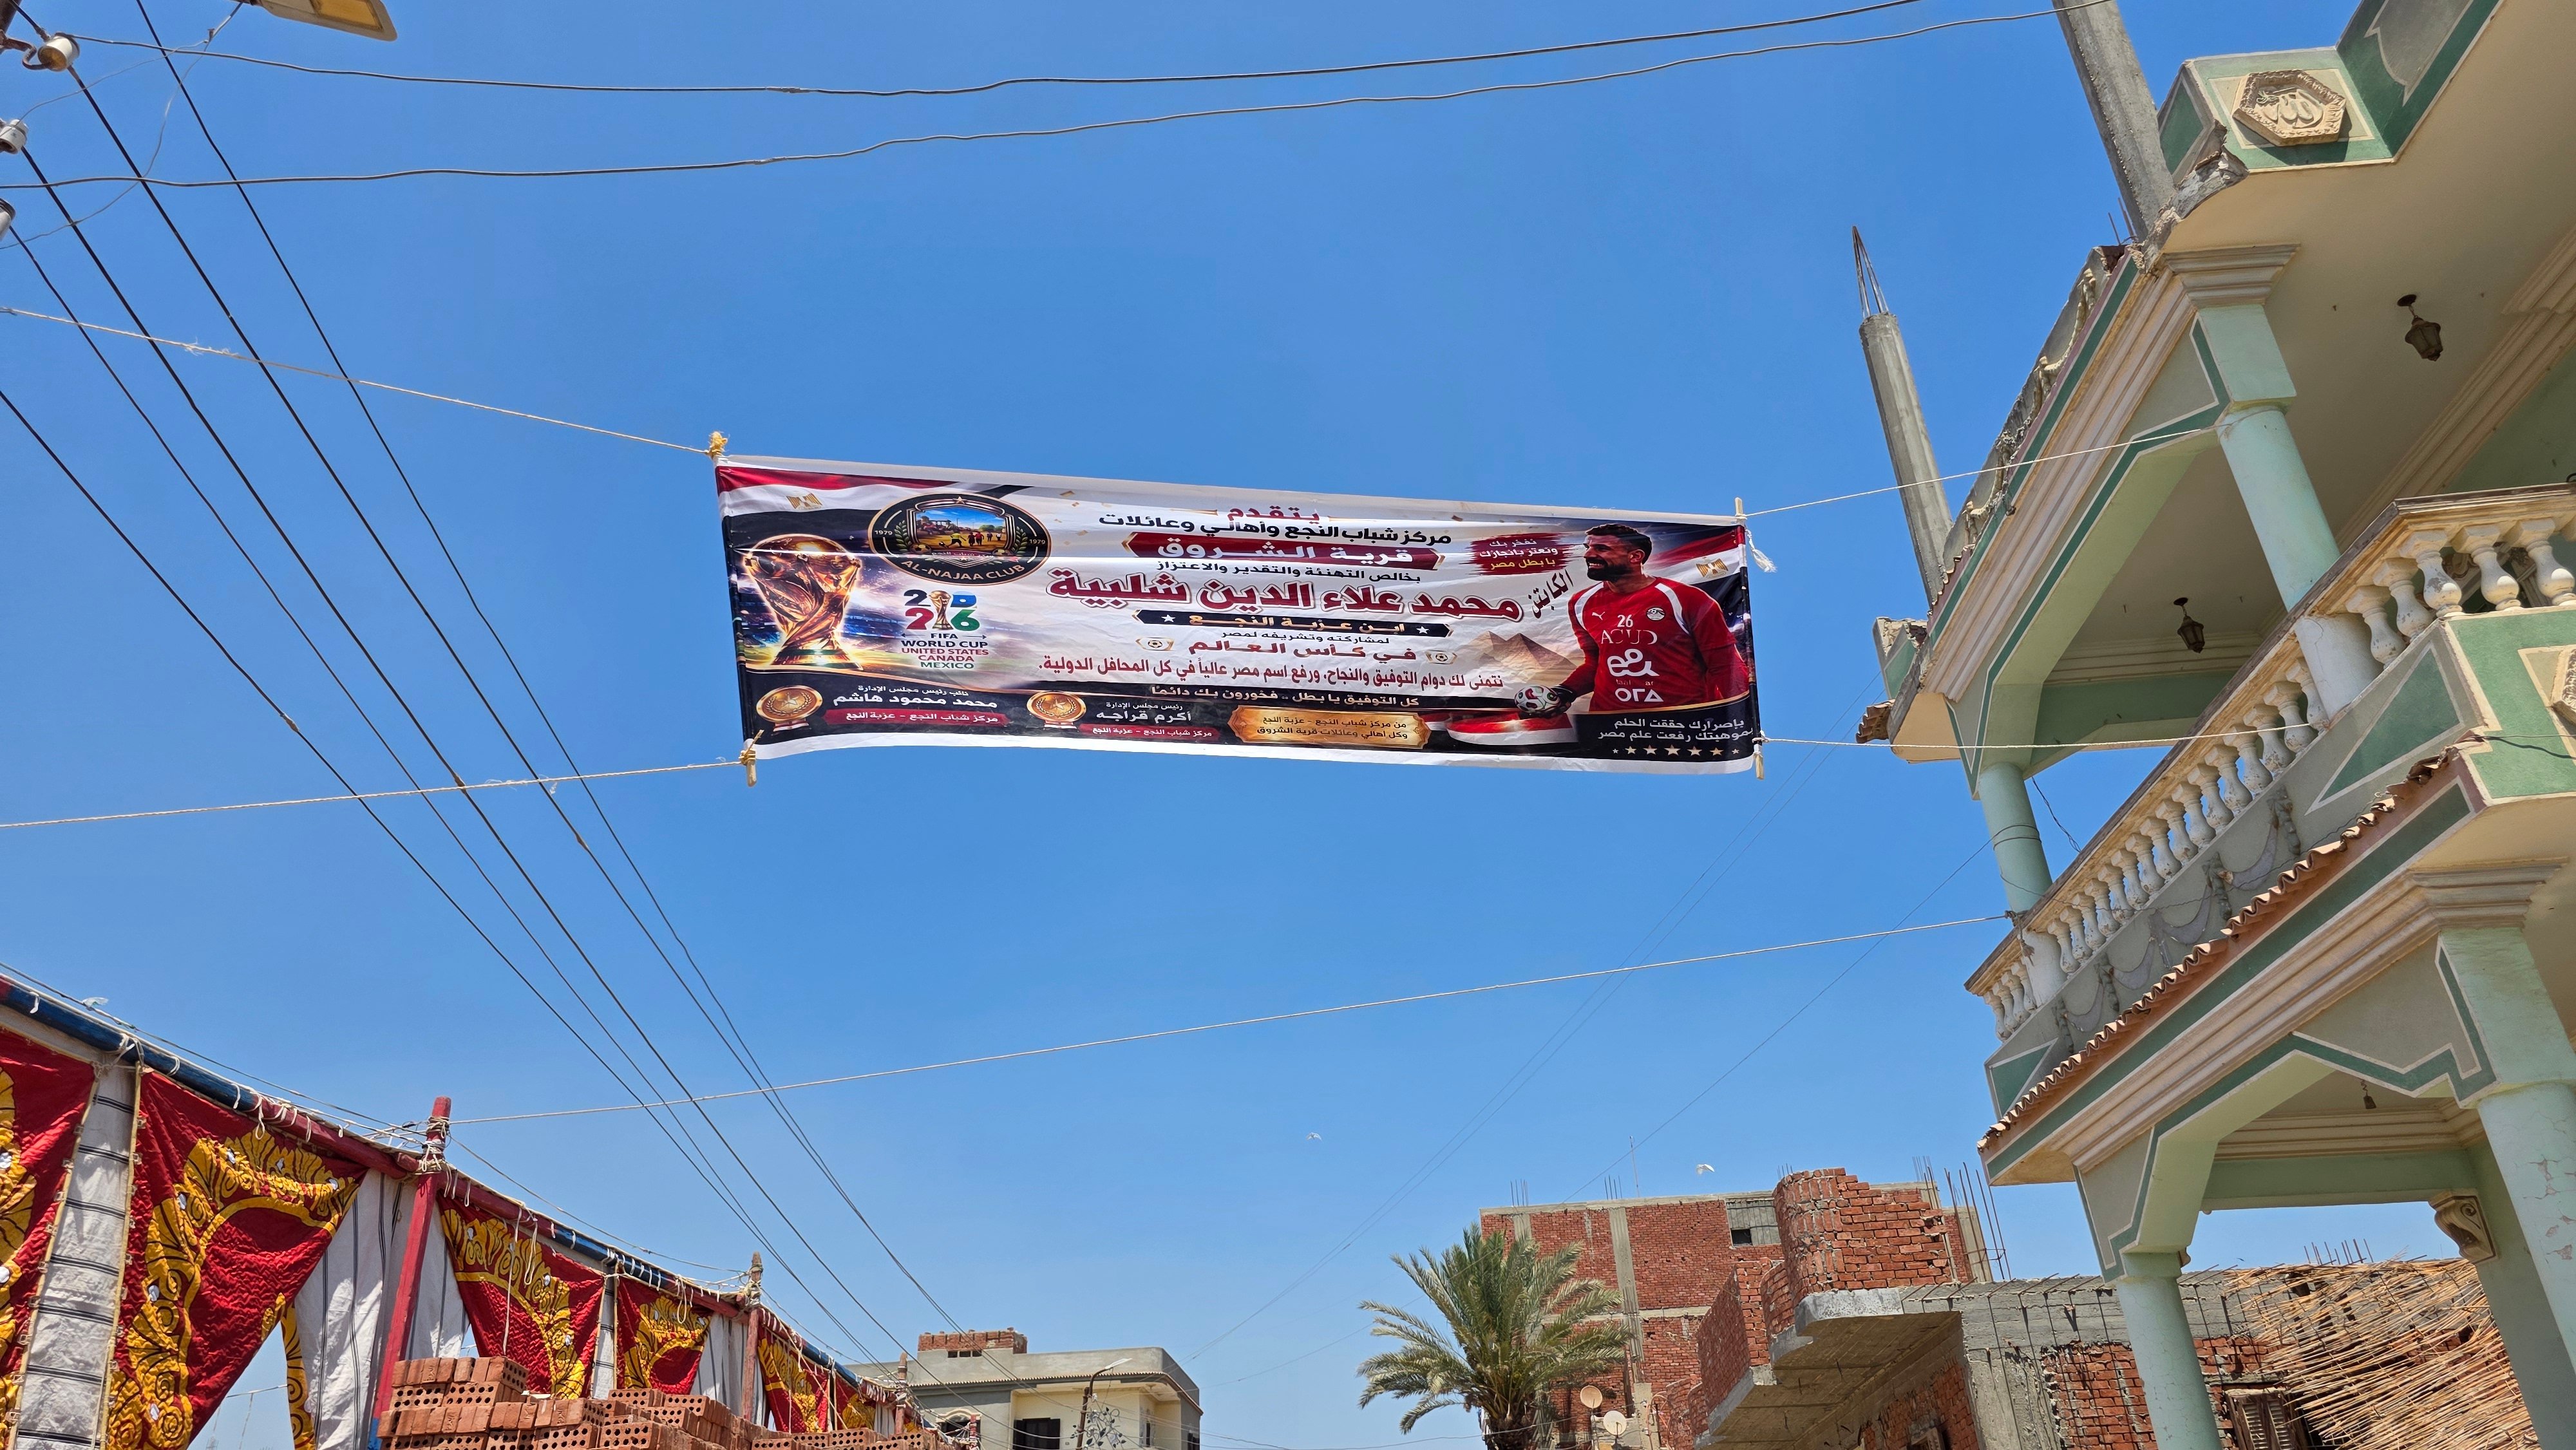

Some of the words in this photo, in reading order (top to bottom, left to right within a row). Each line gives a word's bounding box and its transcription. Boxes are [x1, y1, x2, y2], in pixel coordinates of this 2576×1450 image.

[1227, 505, 1320, 524] يتقدم
[1099, 514, 1195, 532] وعائلات
[1200, 520, 1280, 537] وأهالي
[1285, 525, 1339, 540] النجع
[1342, 527, 1398, 543] شباب
[1400, 531, 1452, 546] مركز
[1158, 537, 1316, 558] الشروق
[1512, 538, 1537, 547] نفخر
[1330, 547, 1413, 565] قرية
[901, 559, 984, 581] AL-NAJAA
[986, 565, 1025, 579] CLUB
[1157, 561, 1228, 573] والاعتزاز
[1490, 561, 1515, 570] مصر
[1519, 559, 1544, 569] بطل
[1233, 565, 1300, 577] والتقدير
[1305, 567, 1365, 578] التهنئة
[1369, 572, 1421, 583] بخالص
[1047, 567, 1191, 608] شلبية
[1197, 579, 1314, 614] الدين
[1321, 584, 1403, 613] علاء
[1408, 592, 1524, 622] محمد
[1189, 615, 1274, 628] النجع
[1281, 617, 1352, 632] عزبة
[1617, 614, 1634, 628] 26
[1359, 623, 1405, 634] ابن
[1262, 632, 1323, 642] وتشريفه
[1327, 636, 1390, 645] لمشاركته
[1189, 640, 1286, 655] العالم
[1293, 644, 1366, 658] كأس
[1373, 648, 1416, 664] في
[1039, 655, 1093, 673] الدولية.
[1097, 657, 1150, 675] المحافل
[1153, 659, 1172, 676] كل
[1177, 660, 1196, 681] في
[1231, 667, 1260, 679] مصر
[1264, 665, 1287, 683] اسم
[1291, 664, 1320, 683] ورفع
[1373, 669, 1417, 687] التوفيق
[1421, 673, 1445, 692] دوام
[1449, 674, 1465, 686] لك
[1470, 675, 1504, 690] نتمنى
[833, 692, 883, 706] هاشم
[1195, 688, 1218, 699] بك
[1222, 690, 1278, 701] فخورون
[1292, 692, 1325, 705] بطل
[1329, 693, 1340, 704] يا
[1344, 694, 1397, 706] التوفيق
[889, 696, 947, 706] محمود
[952, 699, 998, 708] محمد
[1401, 698, 1419, 708] كل
[846, 711, 868, 720] النجع
[869, 711, 896, 720] عزبة
[972, 715, 998, 723] مركز
[1154, 711, 1191, 724] أكرم
[1283, 717, 1305, 725] عزبة
[1614, 718, 1645, 729] الحلم
[1649, 719, 1685, 728] حققت
[1256, 726, 1293, 735] الشروق
[1296, 727, 1318, 735] قرية
[1629, 730, 1652, 741] علم
[1656, 731, 1691, 742] رفعت
